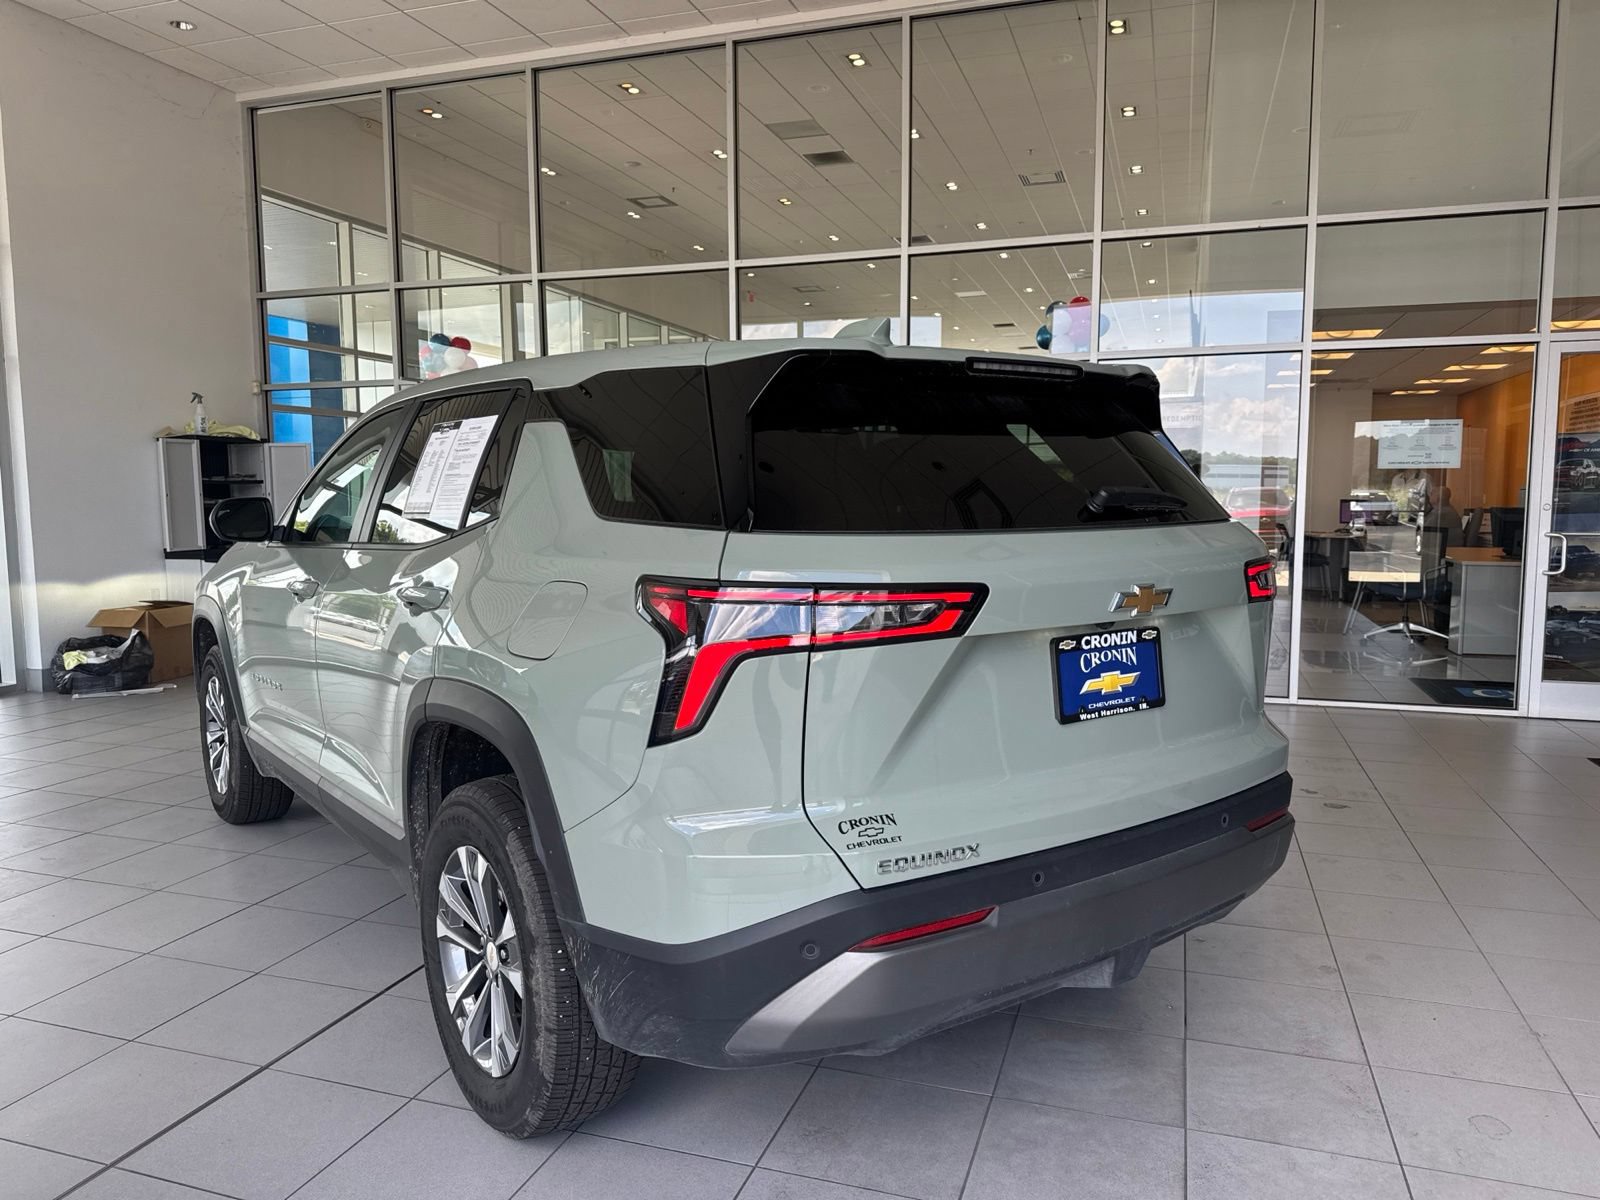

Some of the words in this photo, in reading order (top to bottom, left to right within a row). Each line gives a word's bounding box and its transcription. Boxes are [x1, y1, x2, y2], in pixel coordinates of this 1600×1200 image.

[1081, 631, 1137, 650] CRONIN
[1080, 647, 1137, 673] CRONIN
[1088, 696, 1135, 710] CHEVROLET
[1080, 711, 1099, 721] West
[838, 813, 897, 835] CRONIN
[846, 835, 903, 850] CHEVROLET
[877, 843, 980, 875] EQUINOX
